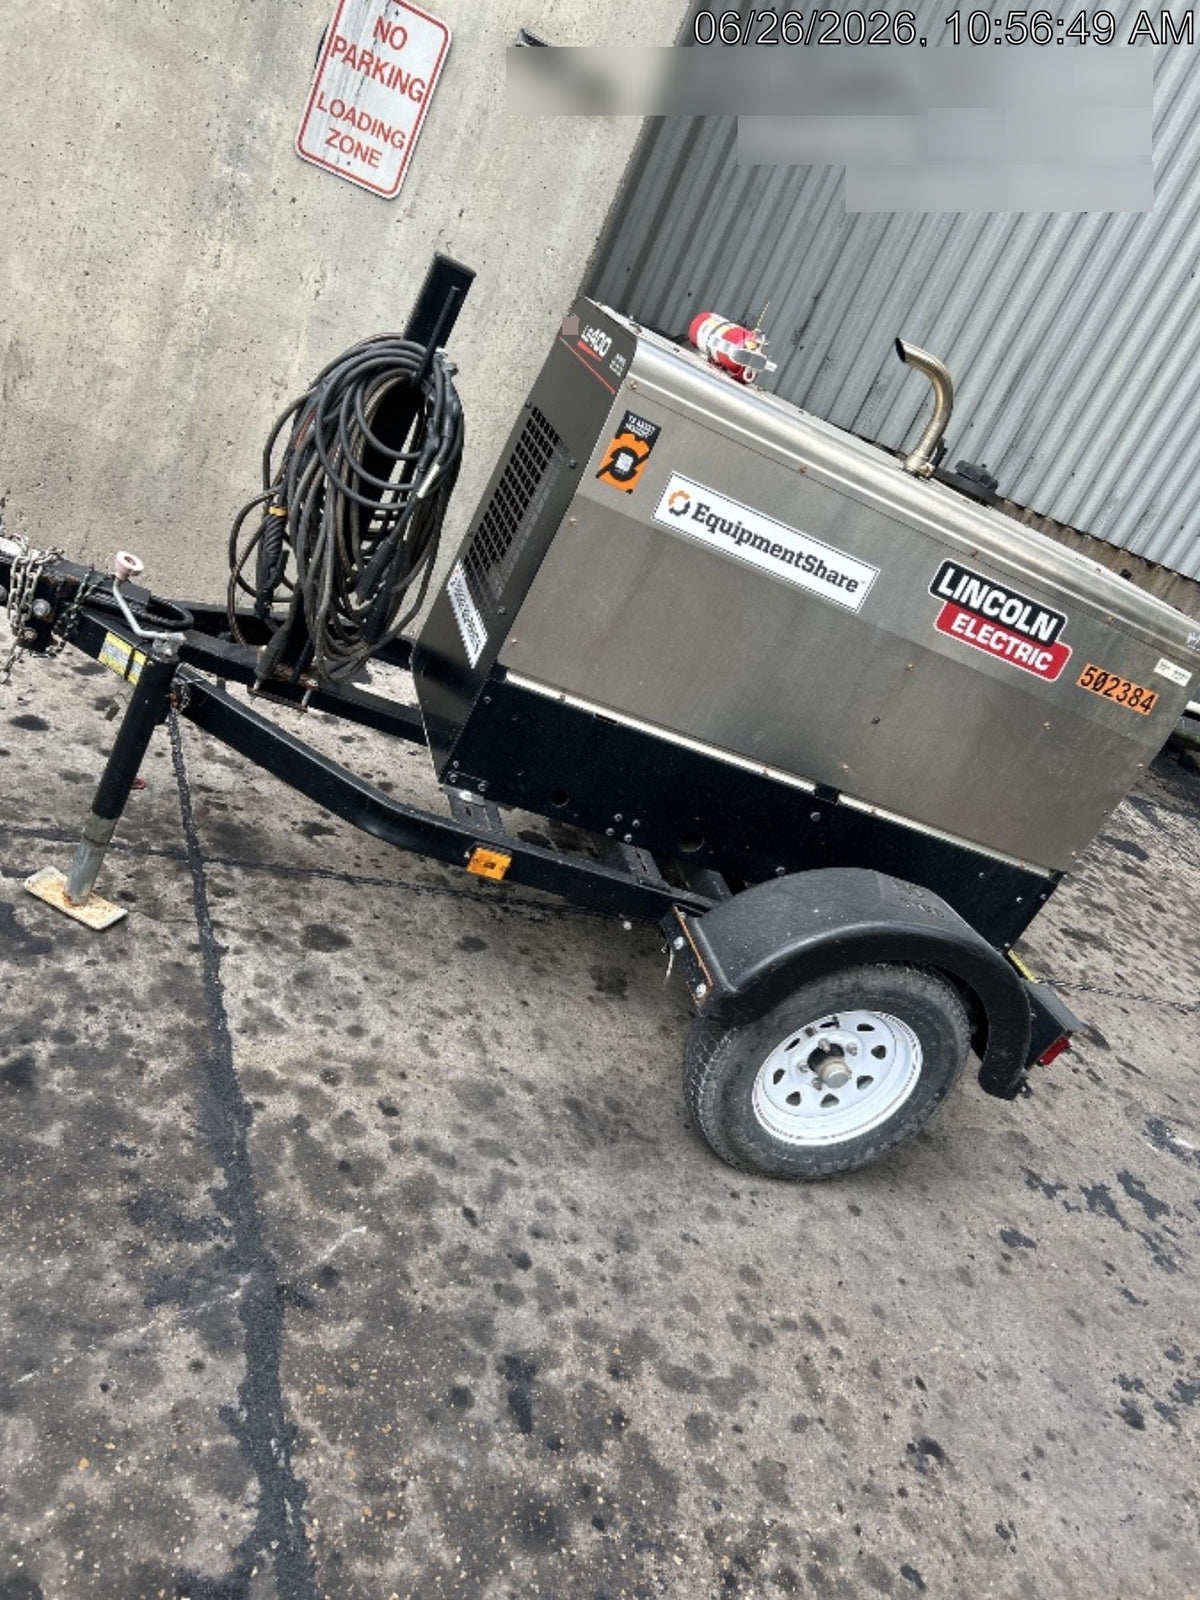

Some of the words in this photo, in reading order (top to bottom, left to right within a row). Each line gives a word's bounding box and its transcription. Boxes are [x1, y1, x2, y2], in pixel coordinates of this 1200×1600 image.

[373, 15, 408, 50] NO
[330, 34, 426, 103] PARKING
[316, 91, 406, 150] LOADING
[324, 127, 383, 169] ZONE
[691, 501, 861, 593] EquipmentShare
[937, 567, 1059, 643] LINCOLN
[950, 612, 1054, 672] ELECTRIC
[1079, 665, 1157, 713] 502384
